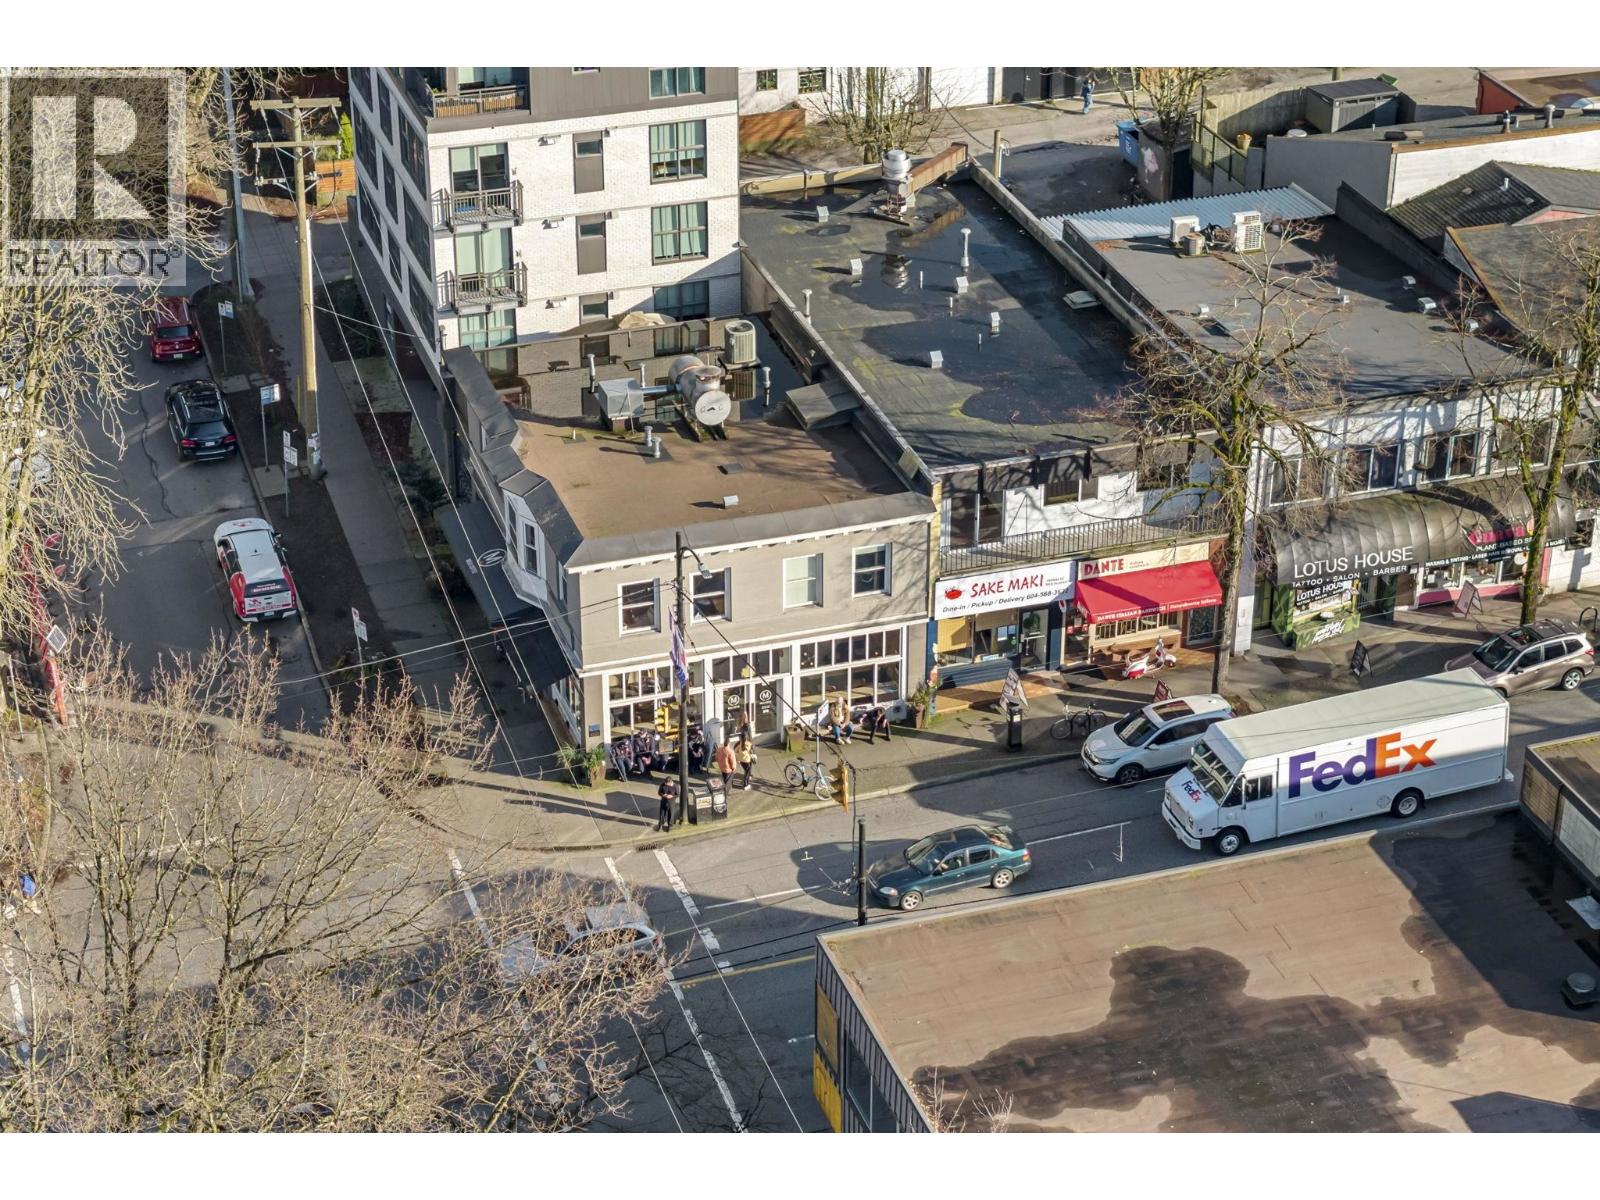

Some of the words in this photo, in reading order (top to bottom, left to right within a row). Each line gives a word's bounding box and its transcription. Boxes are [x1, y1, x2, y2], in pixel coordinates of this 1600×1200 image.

[1084, 558, 1124, 576] DANTE
[1294, 557, 1348, 579] LOTUS
[1354, 545, 1414, 569] HOUSE
[970, 581, 1005, 598] SAKE
[1007, 574, 1044, 595] MAKI
[1291, 577, 1323, 588] TATTOO
[1333, 572, 1360, 583] SALON
[1373, 565, 1407, 576] BARBER
[971, 599, 993, 609] Pickup
[998, 595, 1025, 605] Delivery
[1296, 585, 1321, 602] LOTUS
[1288, 731, 1438, 799] FedEx
[1181, 780, 1202, 802] FedEx
